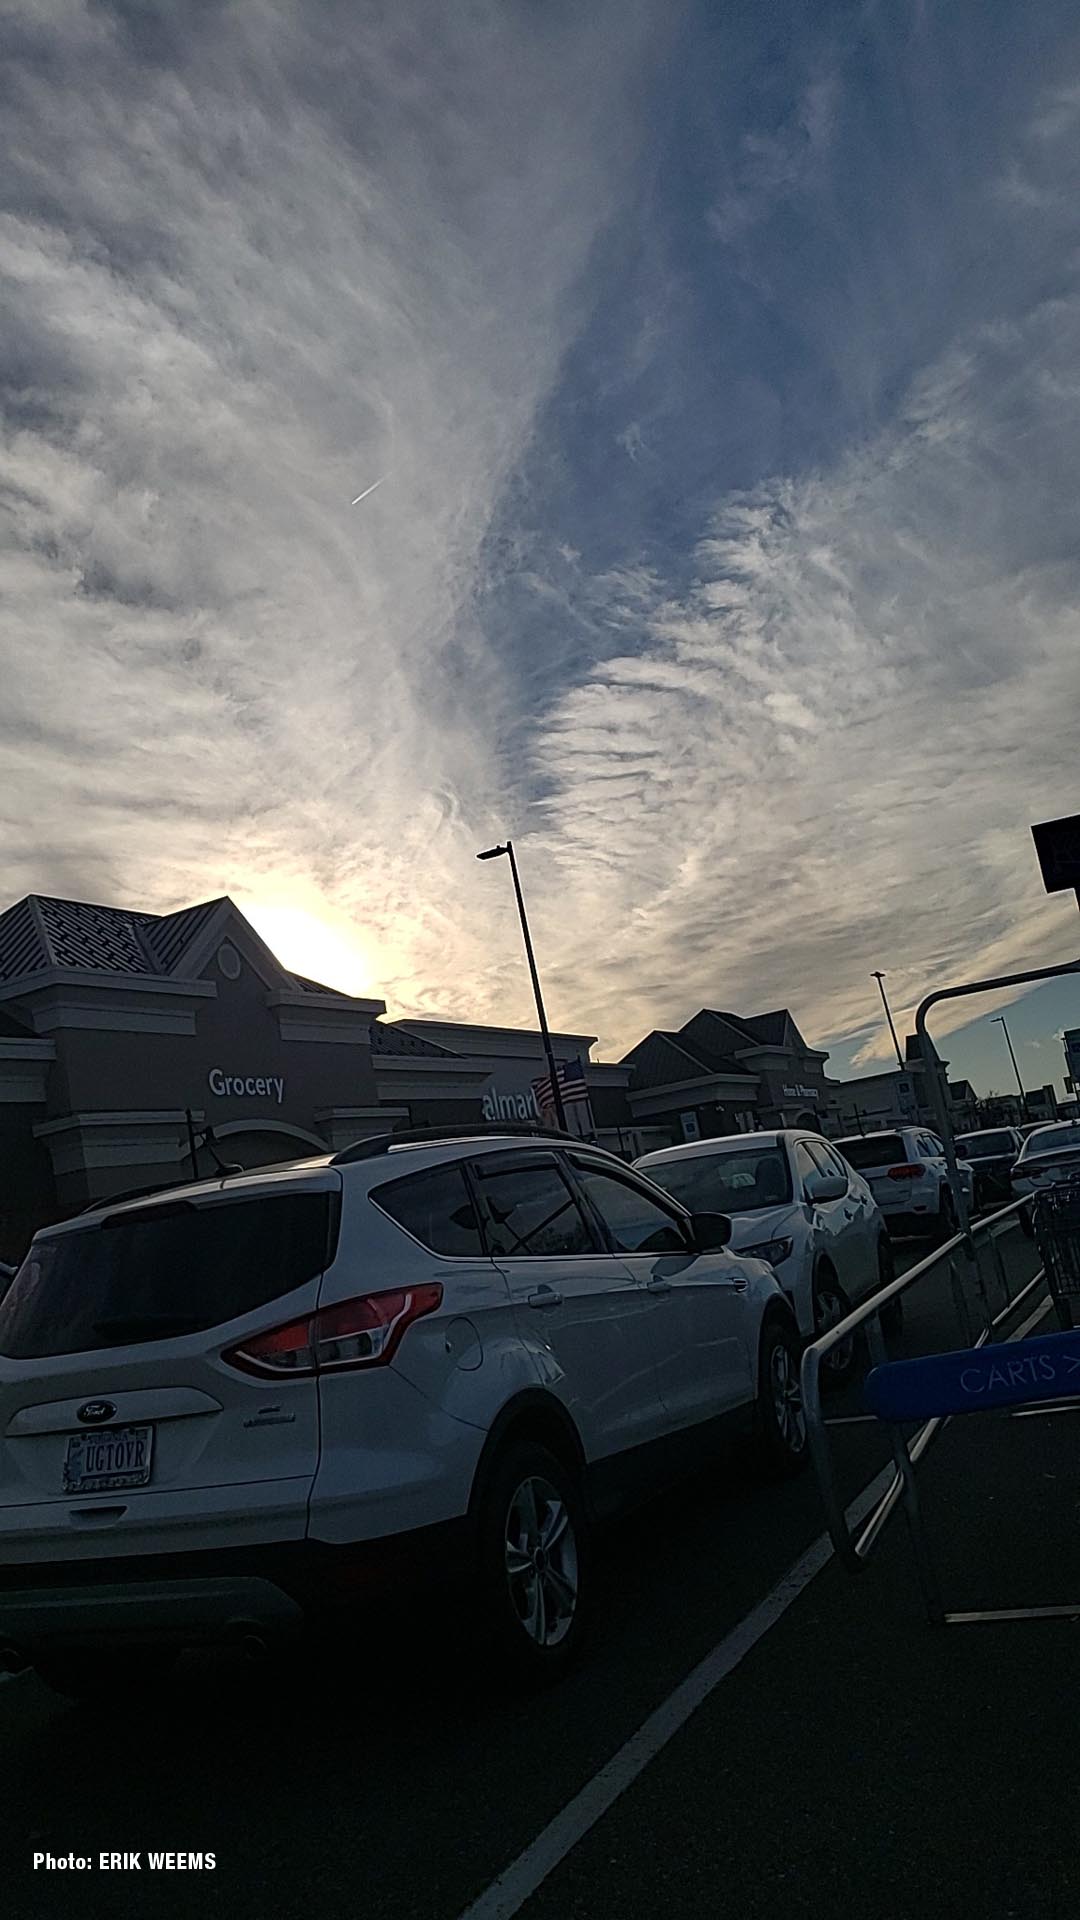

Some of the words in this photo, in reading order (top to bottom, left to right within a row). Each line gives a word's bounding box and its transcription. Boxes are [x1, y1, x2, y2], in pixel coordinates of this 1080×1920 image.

[208, 1068, 284, 1104] Grocery
[482, 1086, 541, 1120] almart
[959, 1355, 1056, 1393] CARTS
